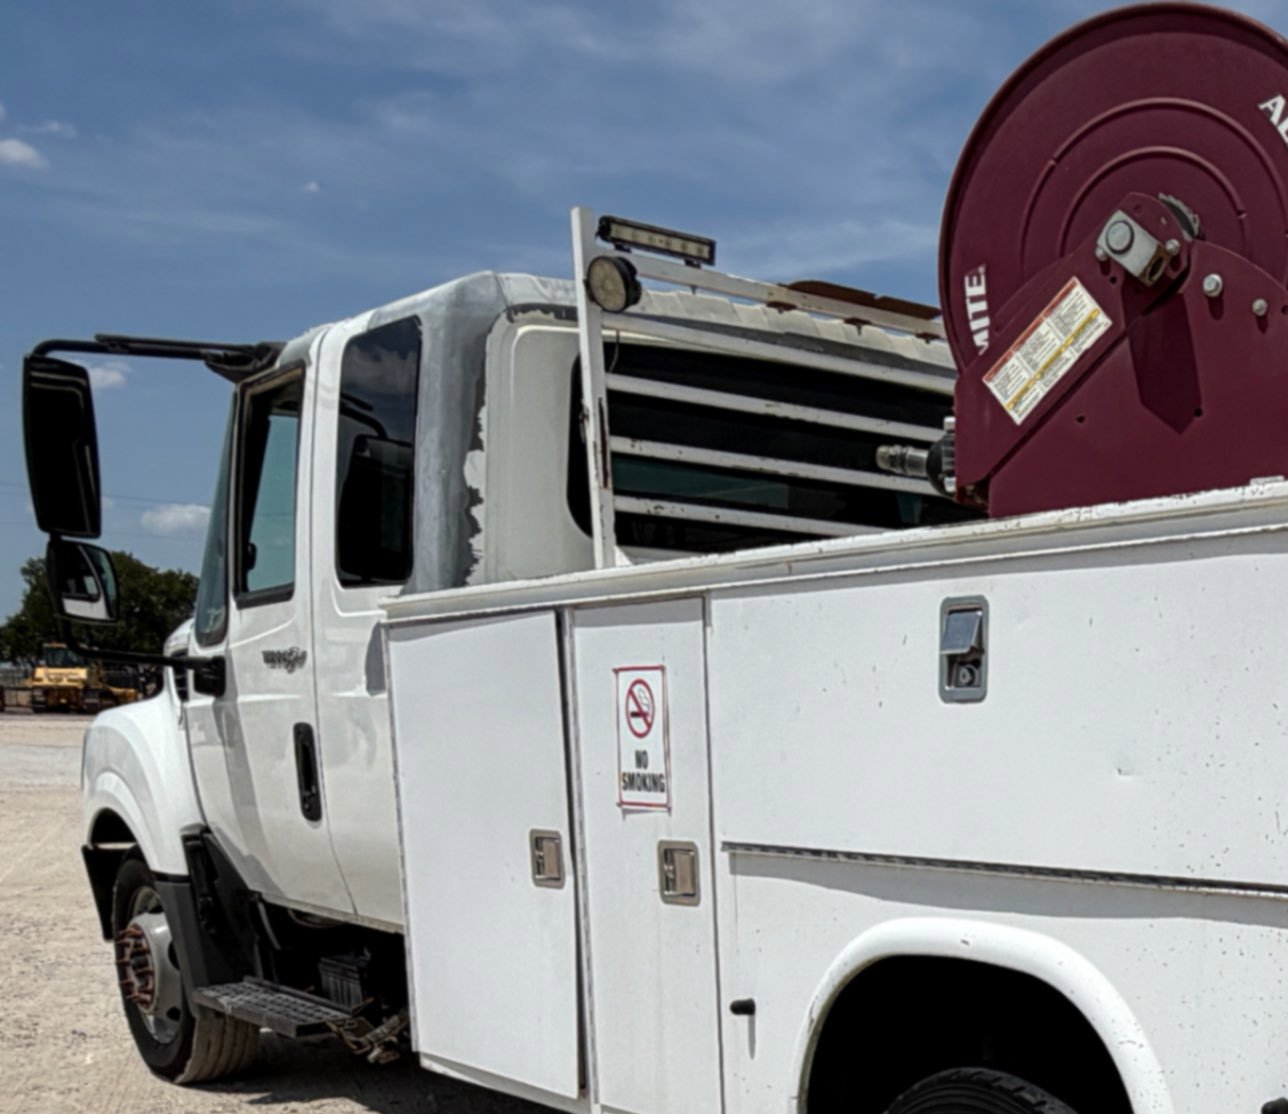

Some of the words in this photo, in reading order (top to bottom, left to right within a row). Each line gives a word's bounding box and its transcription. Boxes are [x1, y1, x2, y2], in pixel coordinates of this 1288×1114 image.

[964, 274, 990, 355] MITE
[635, 749, 649, 770] NO
[622, 771, 665, 793] SMOKING
